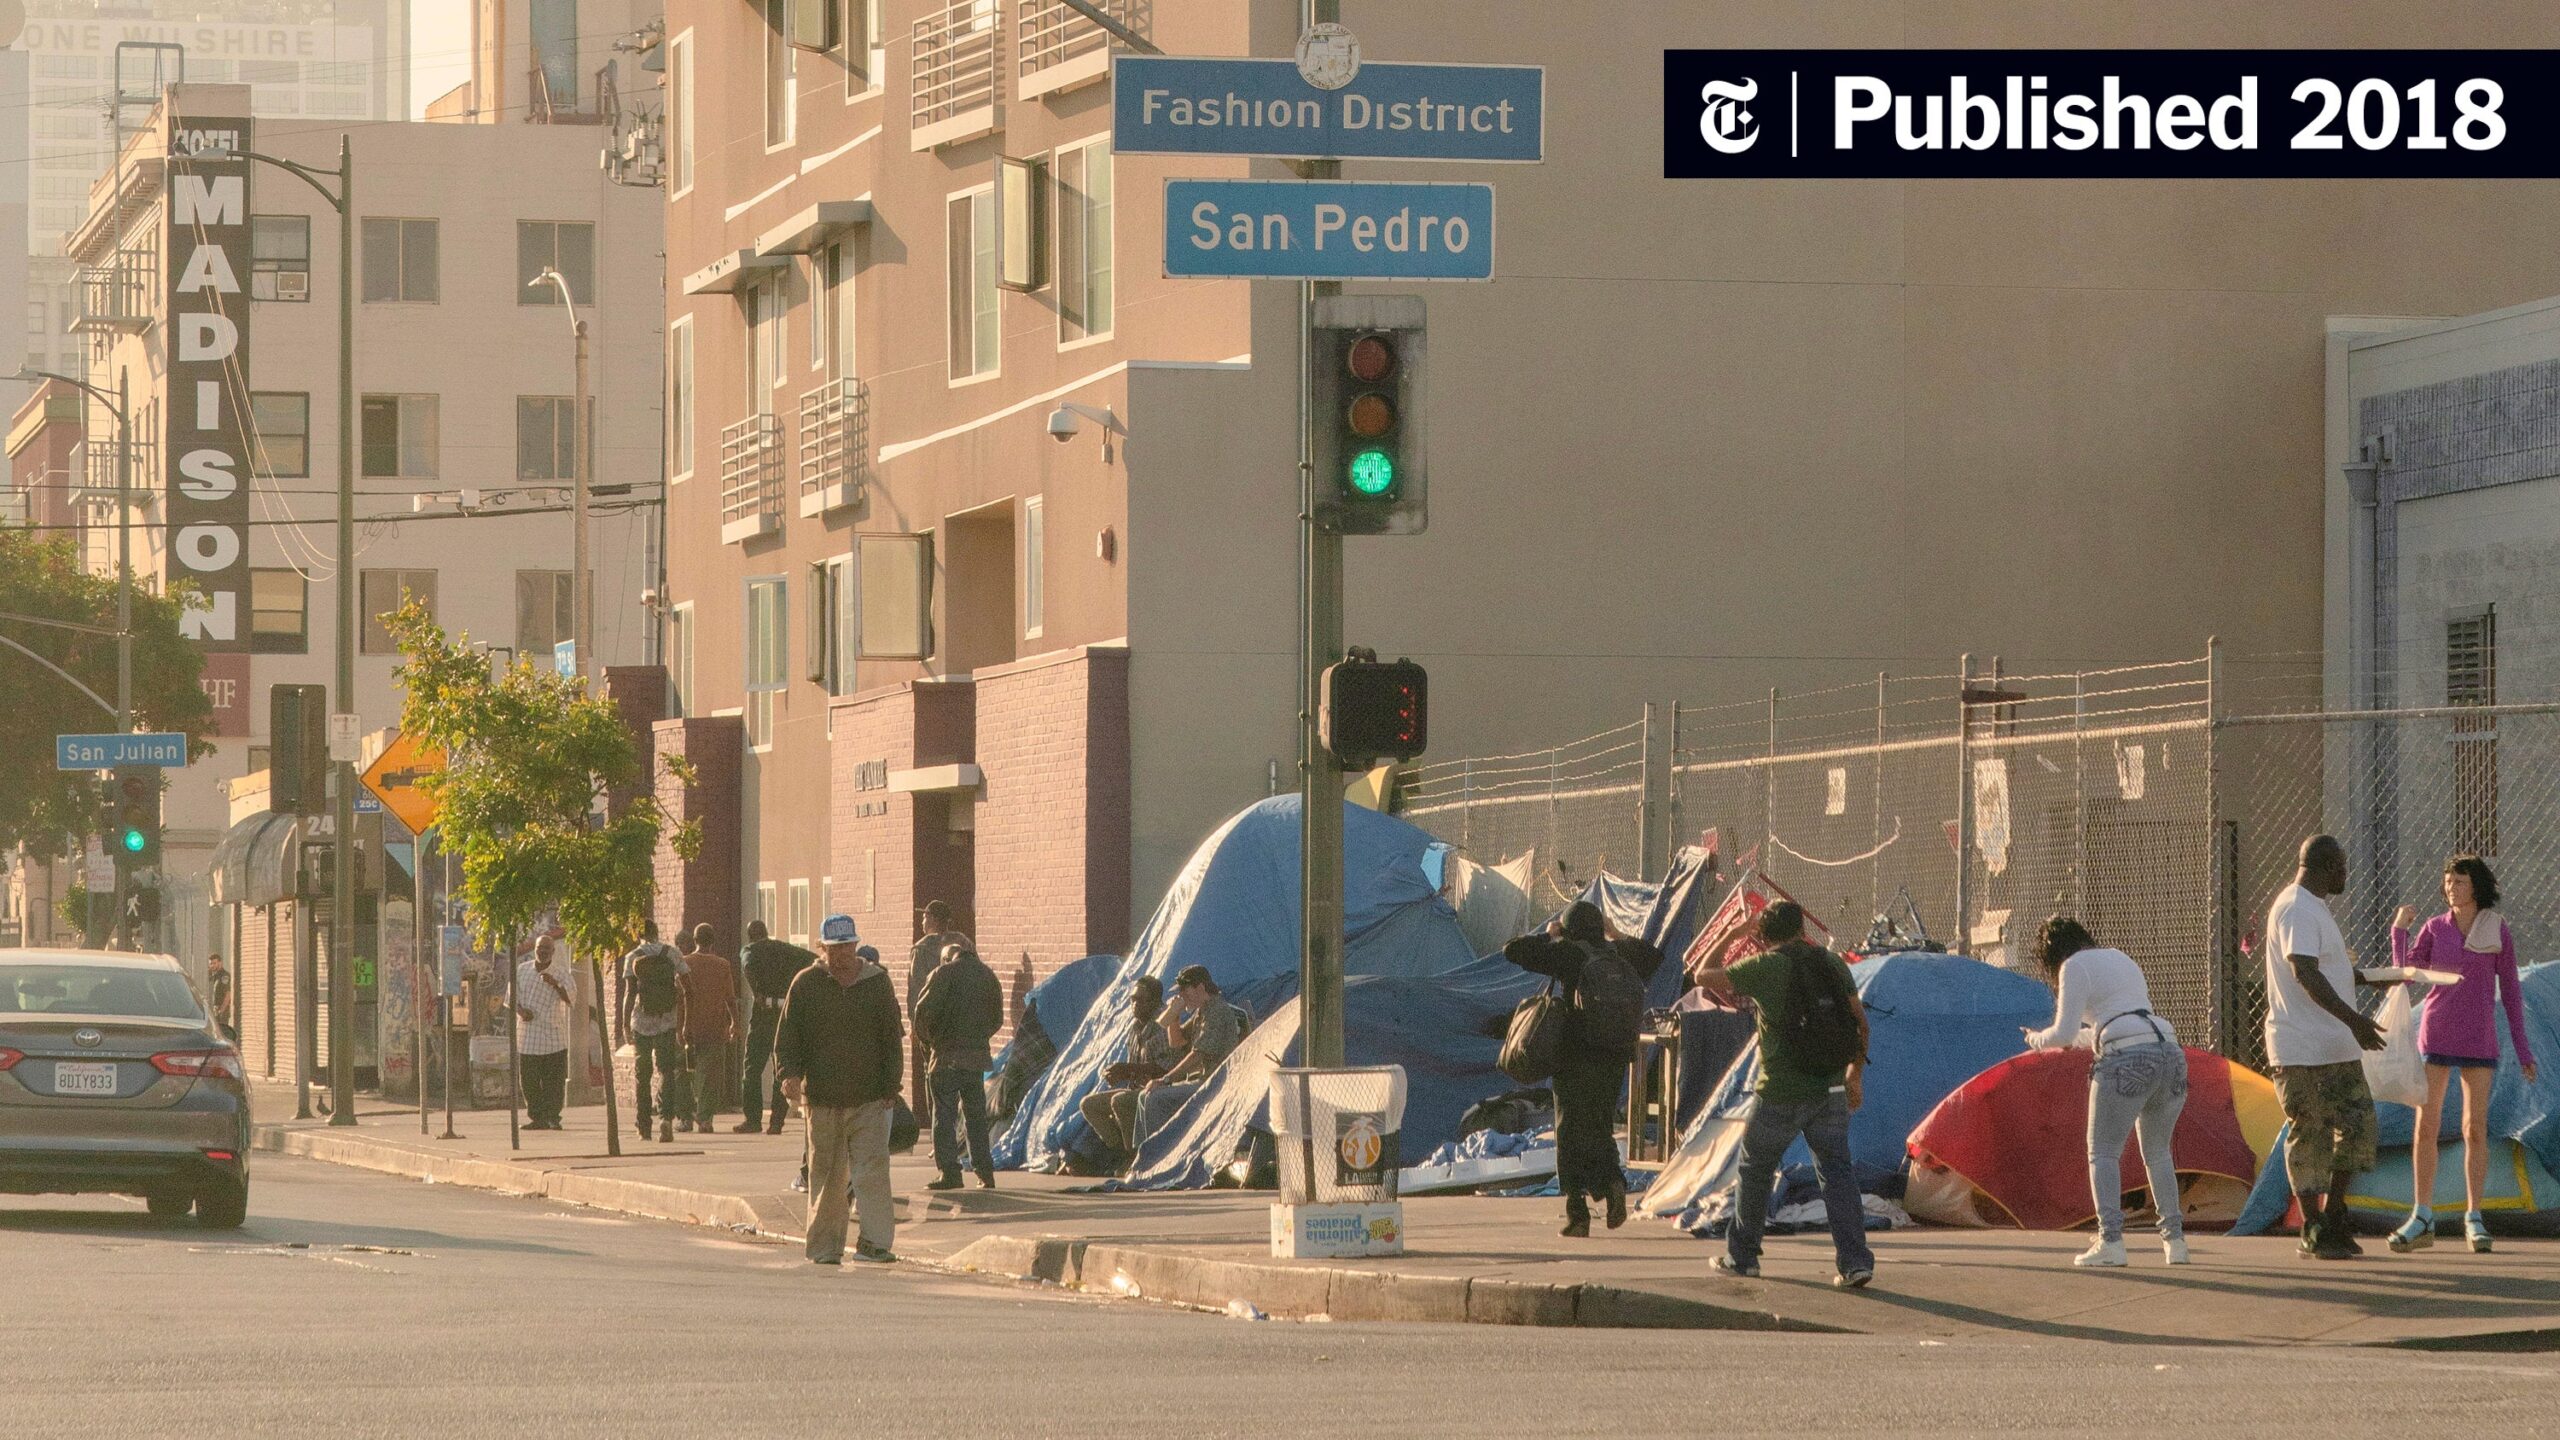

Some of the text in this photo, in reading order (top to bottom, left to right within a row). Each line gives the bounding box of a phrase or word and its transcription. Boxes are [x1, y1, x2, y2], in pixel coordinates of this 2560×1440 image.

[23, 24, 315, 57] ONE WILSHIRE
[1143, 90, 1514, 134] Fashion District
[1191, 202, 1470, 252] San Pedro
[174, 175, 244, 640] MADISON
[67, 743, 177, 761] San Julian
[59, 1073, 113, 1090] 8DIY833
[1306, 1227, 1371, 1245] California
